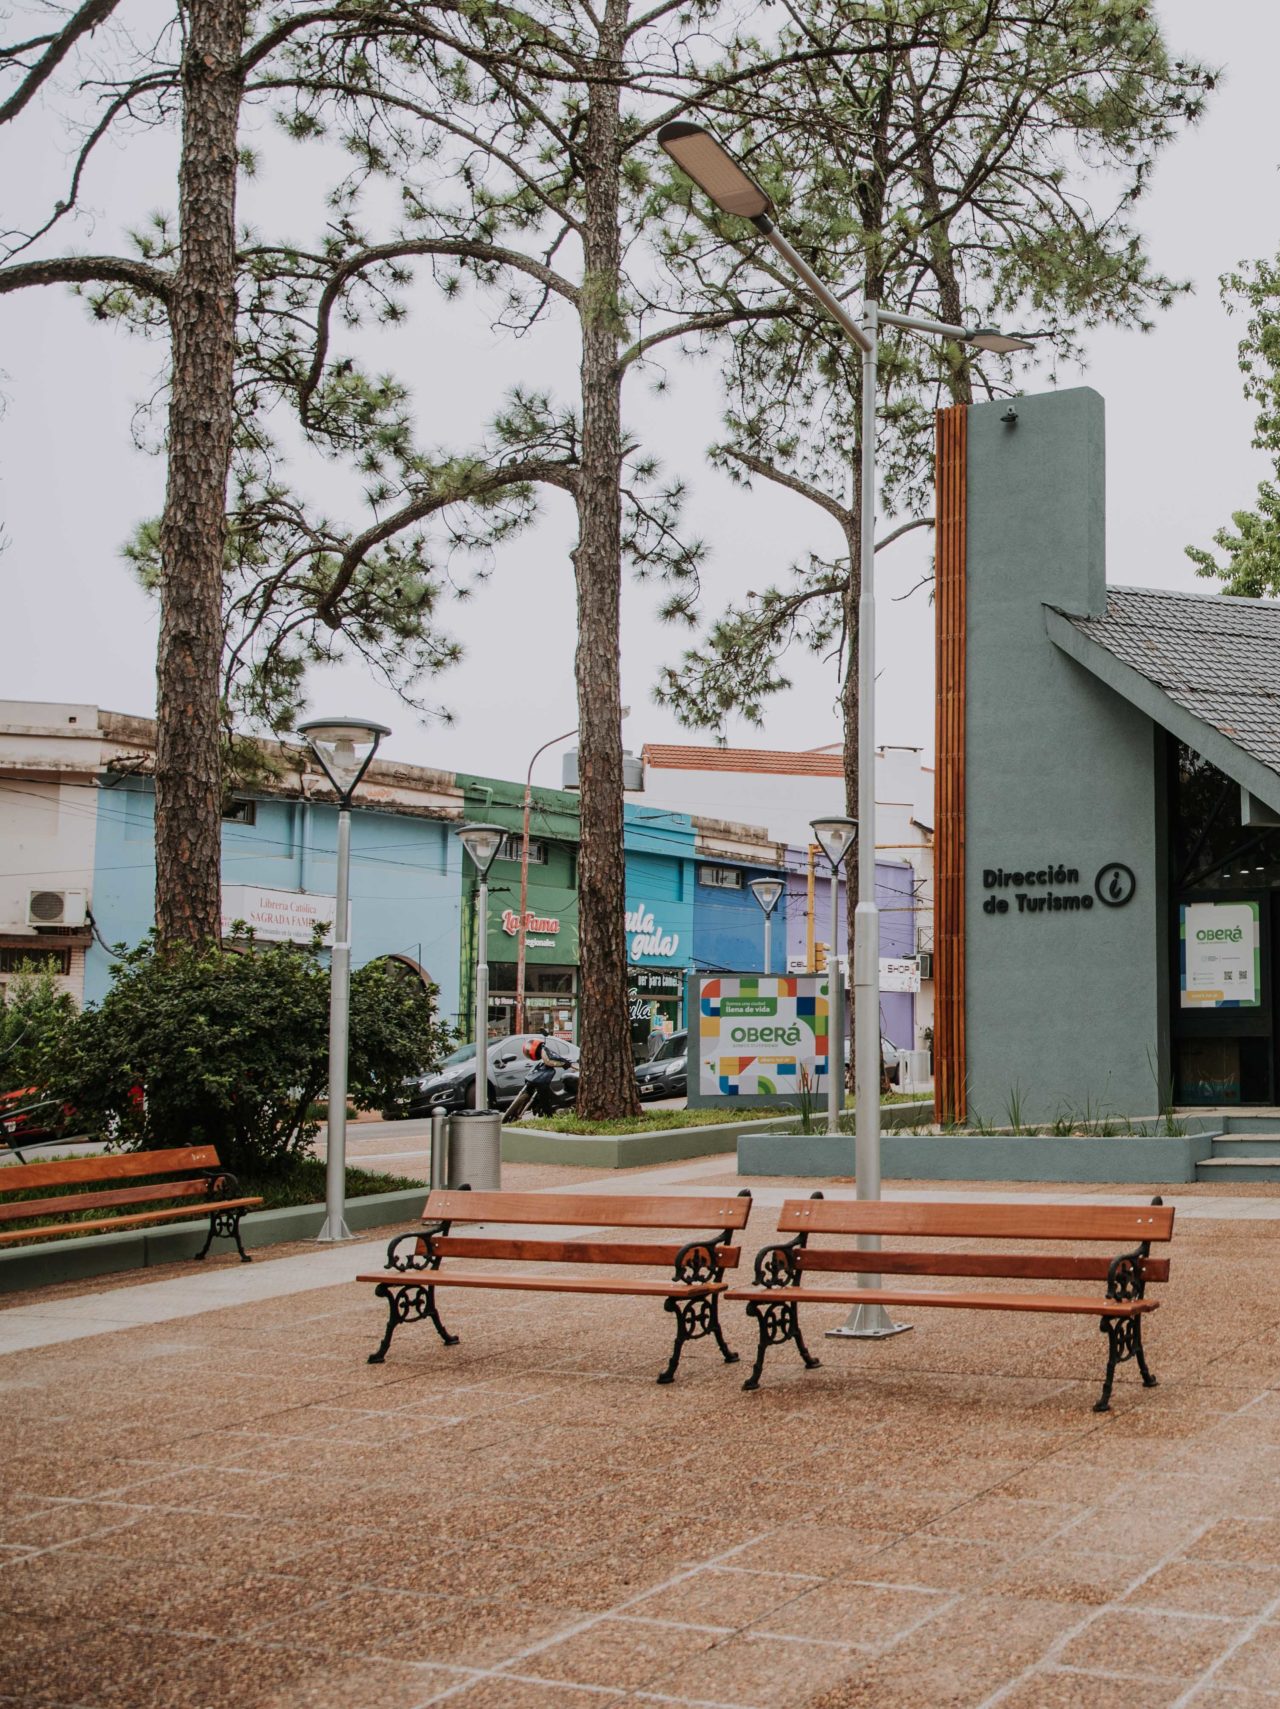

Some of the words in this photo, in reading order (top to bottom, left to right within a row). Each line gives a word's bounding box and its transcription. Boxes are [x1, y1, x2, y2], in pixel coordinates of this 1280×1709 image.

[983, 864, 1079, 888] Dirección
[983, 895, 1009, 914] de
[1015, 892, 1094, 912] Turismo
[251, 912, 290, 926] SAGRADA
[502, 910, 520, 936] La
[522, 911, 560, 933] Fama
[625, 903, 655, 933] ula
[631, 926, 679, 961] gula
[888, 964, 910, 973] SHOP
